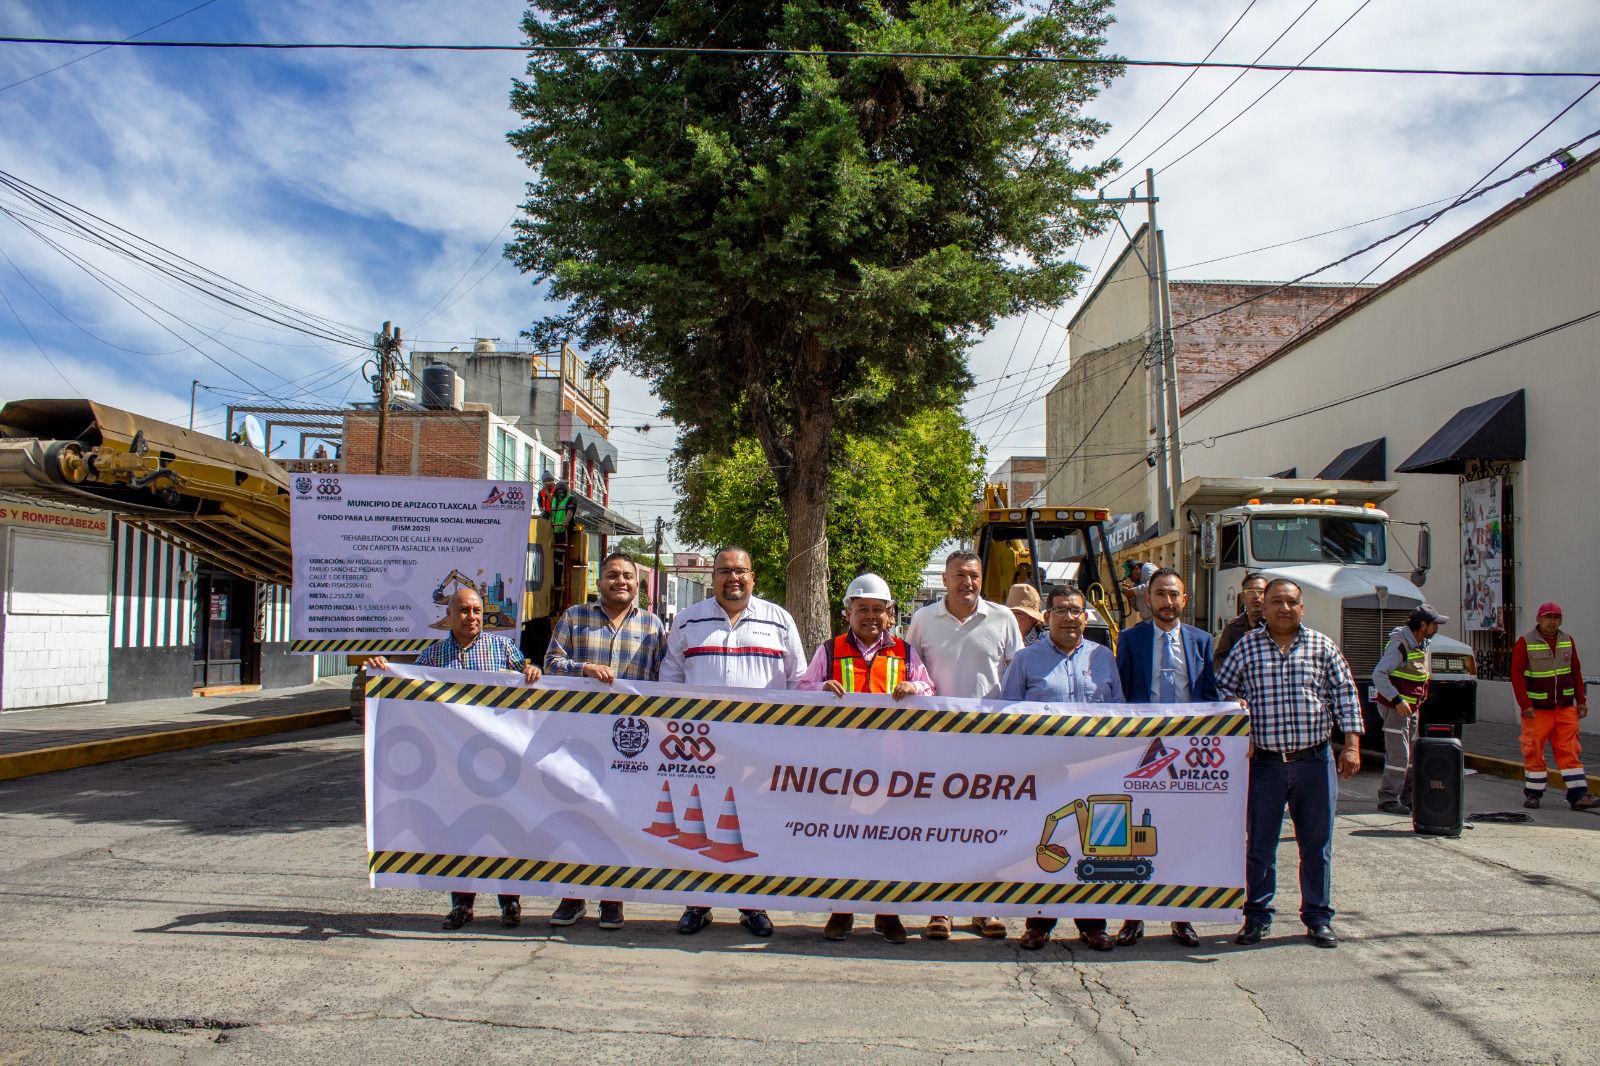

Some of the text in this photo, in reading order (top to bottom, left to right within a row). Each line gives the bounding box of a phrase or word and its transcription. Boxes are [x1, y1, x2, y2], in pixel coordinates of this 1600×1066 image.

[347, 500, 390, 508] MUNICIPIO
[403, 501, 437, 509] APIZACO
[439, 502, 478, 510] TLAXCALA
[11, 510, 18, 519] Y
[22, 511, 106, 531] ROMPECABEZAS
[344, 514, 363, 522] PARA
[400, 535, 409, 543] DE
[410, 535, 431, 543] CALLE
[369, 544, 399, 552] CARPETA
[308, 557, 346, 565] UBICACIÓN:
[611, 763, 649, 771] APIZACO
[657, 763, 716, 775] APIZACO
[769, 765, 1037, 801] INICIO DE OBRA
[1123, 780, 1228, 791] OBRAS PUBLICAS
[785, 821, 1008, 844] “POR UN MEJOR FUTURO”
